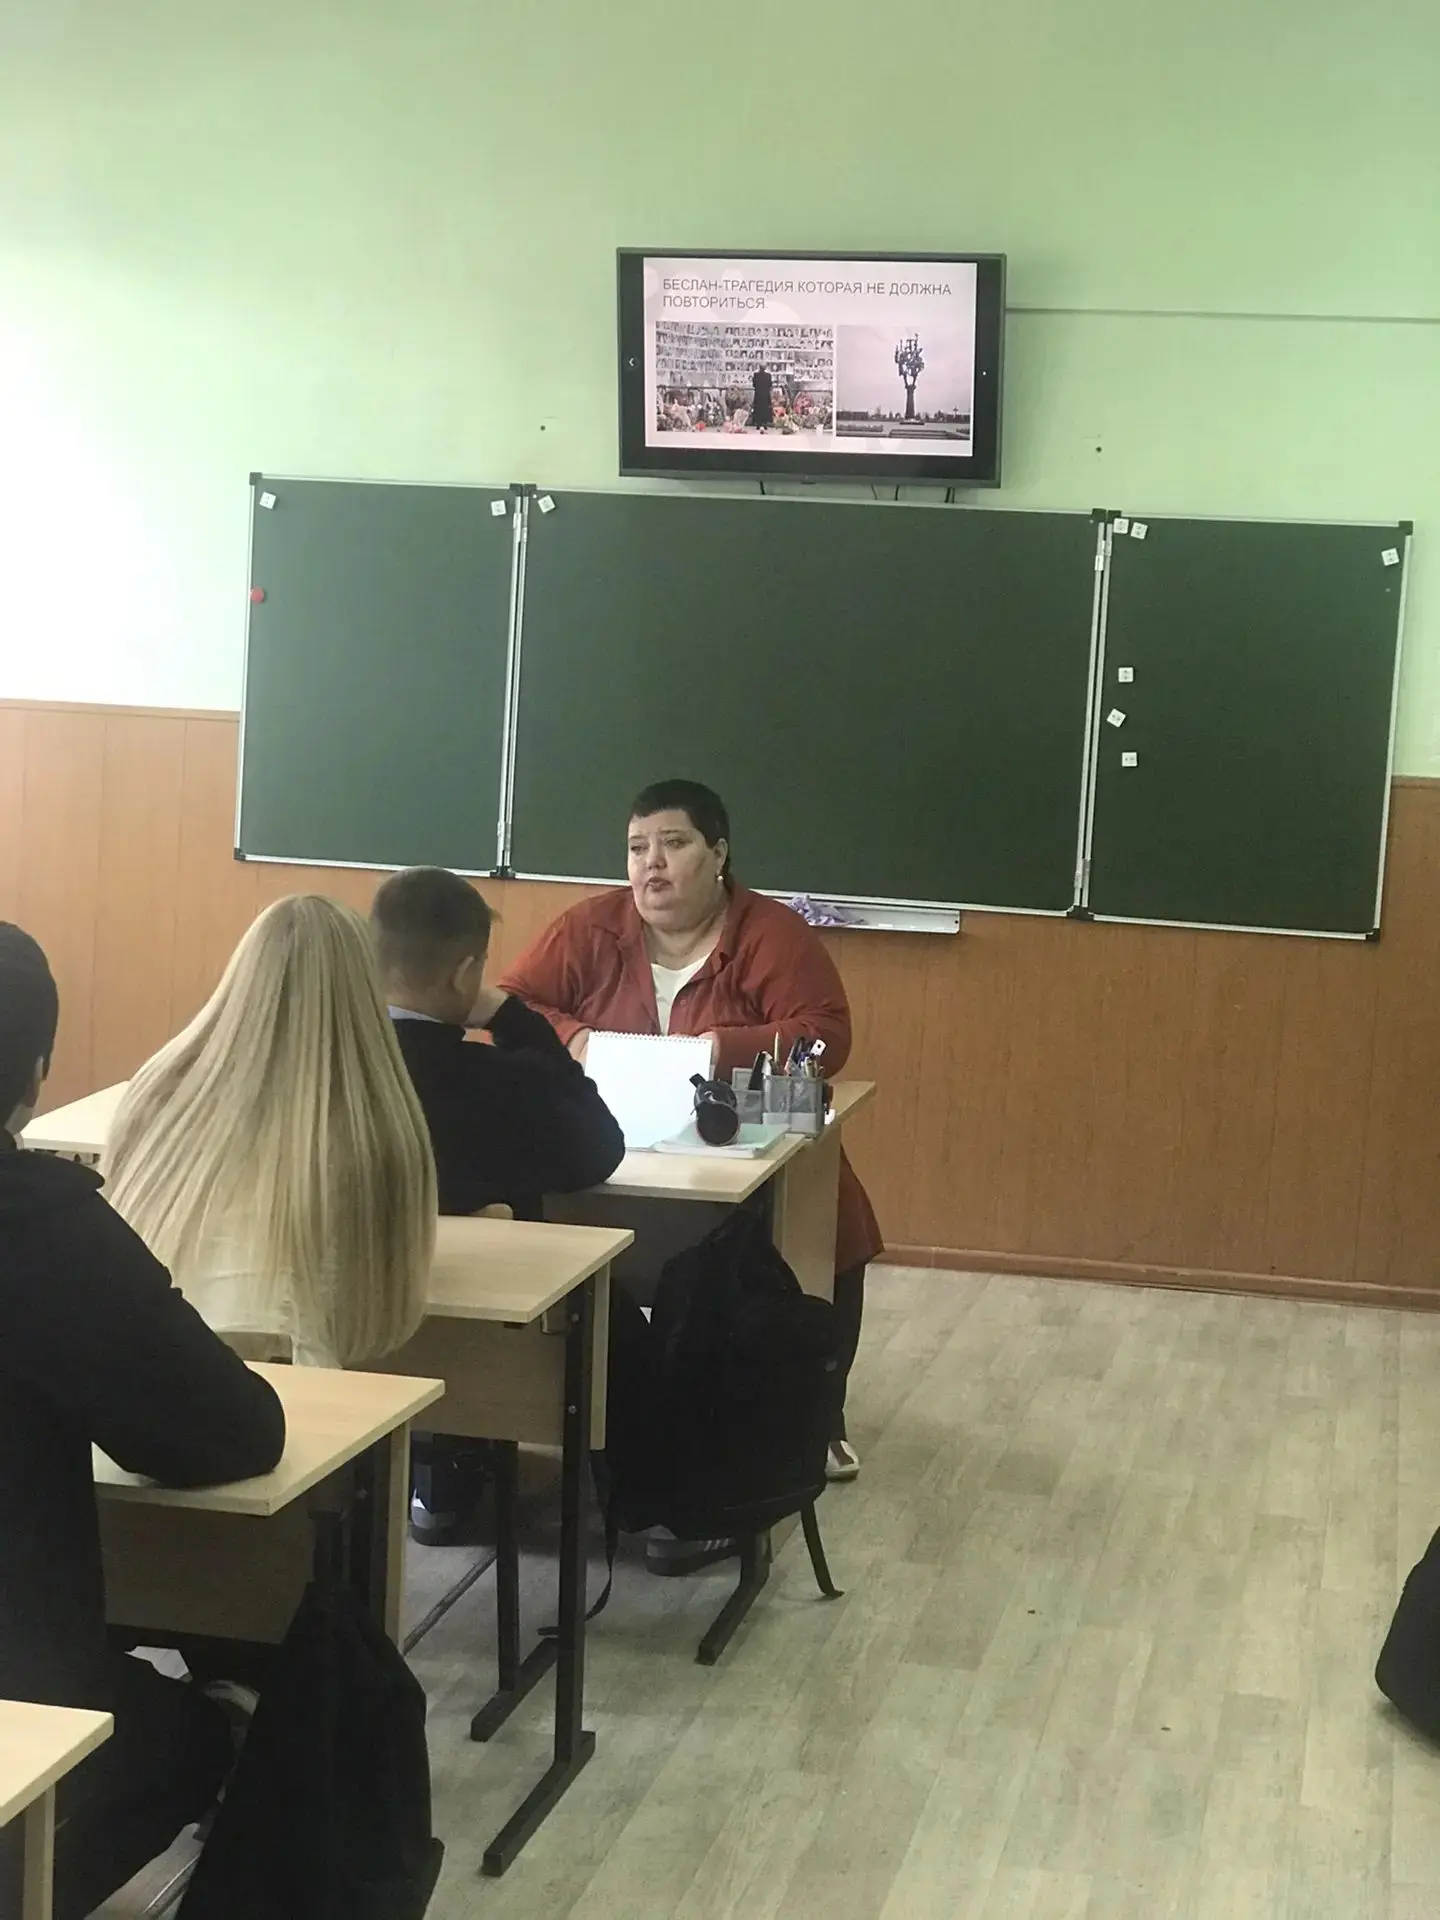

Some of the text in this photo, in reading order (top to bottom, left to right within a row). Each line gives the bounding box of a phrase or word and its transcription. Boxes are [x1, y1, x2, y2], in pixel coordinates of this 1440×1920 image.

[797, 281, 862, 294] КОТОРАЯ
[866, 282, 885, 294] НЕ
[889, 282, 952, 296] ДОЛЖНА
